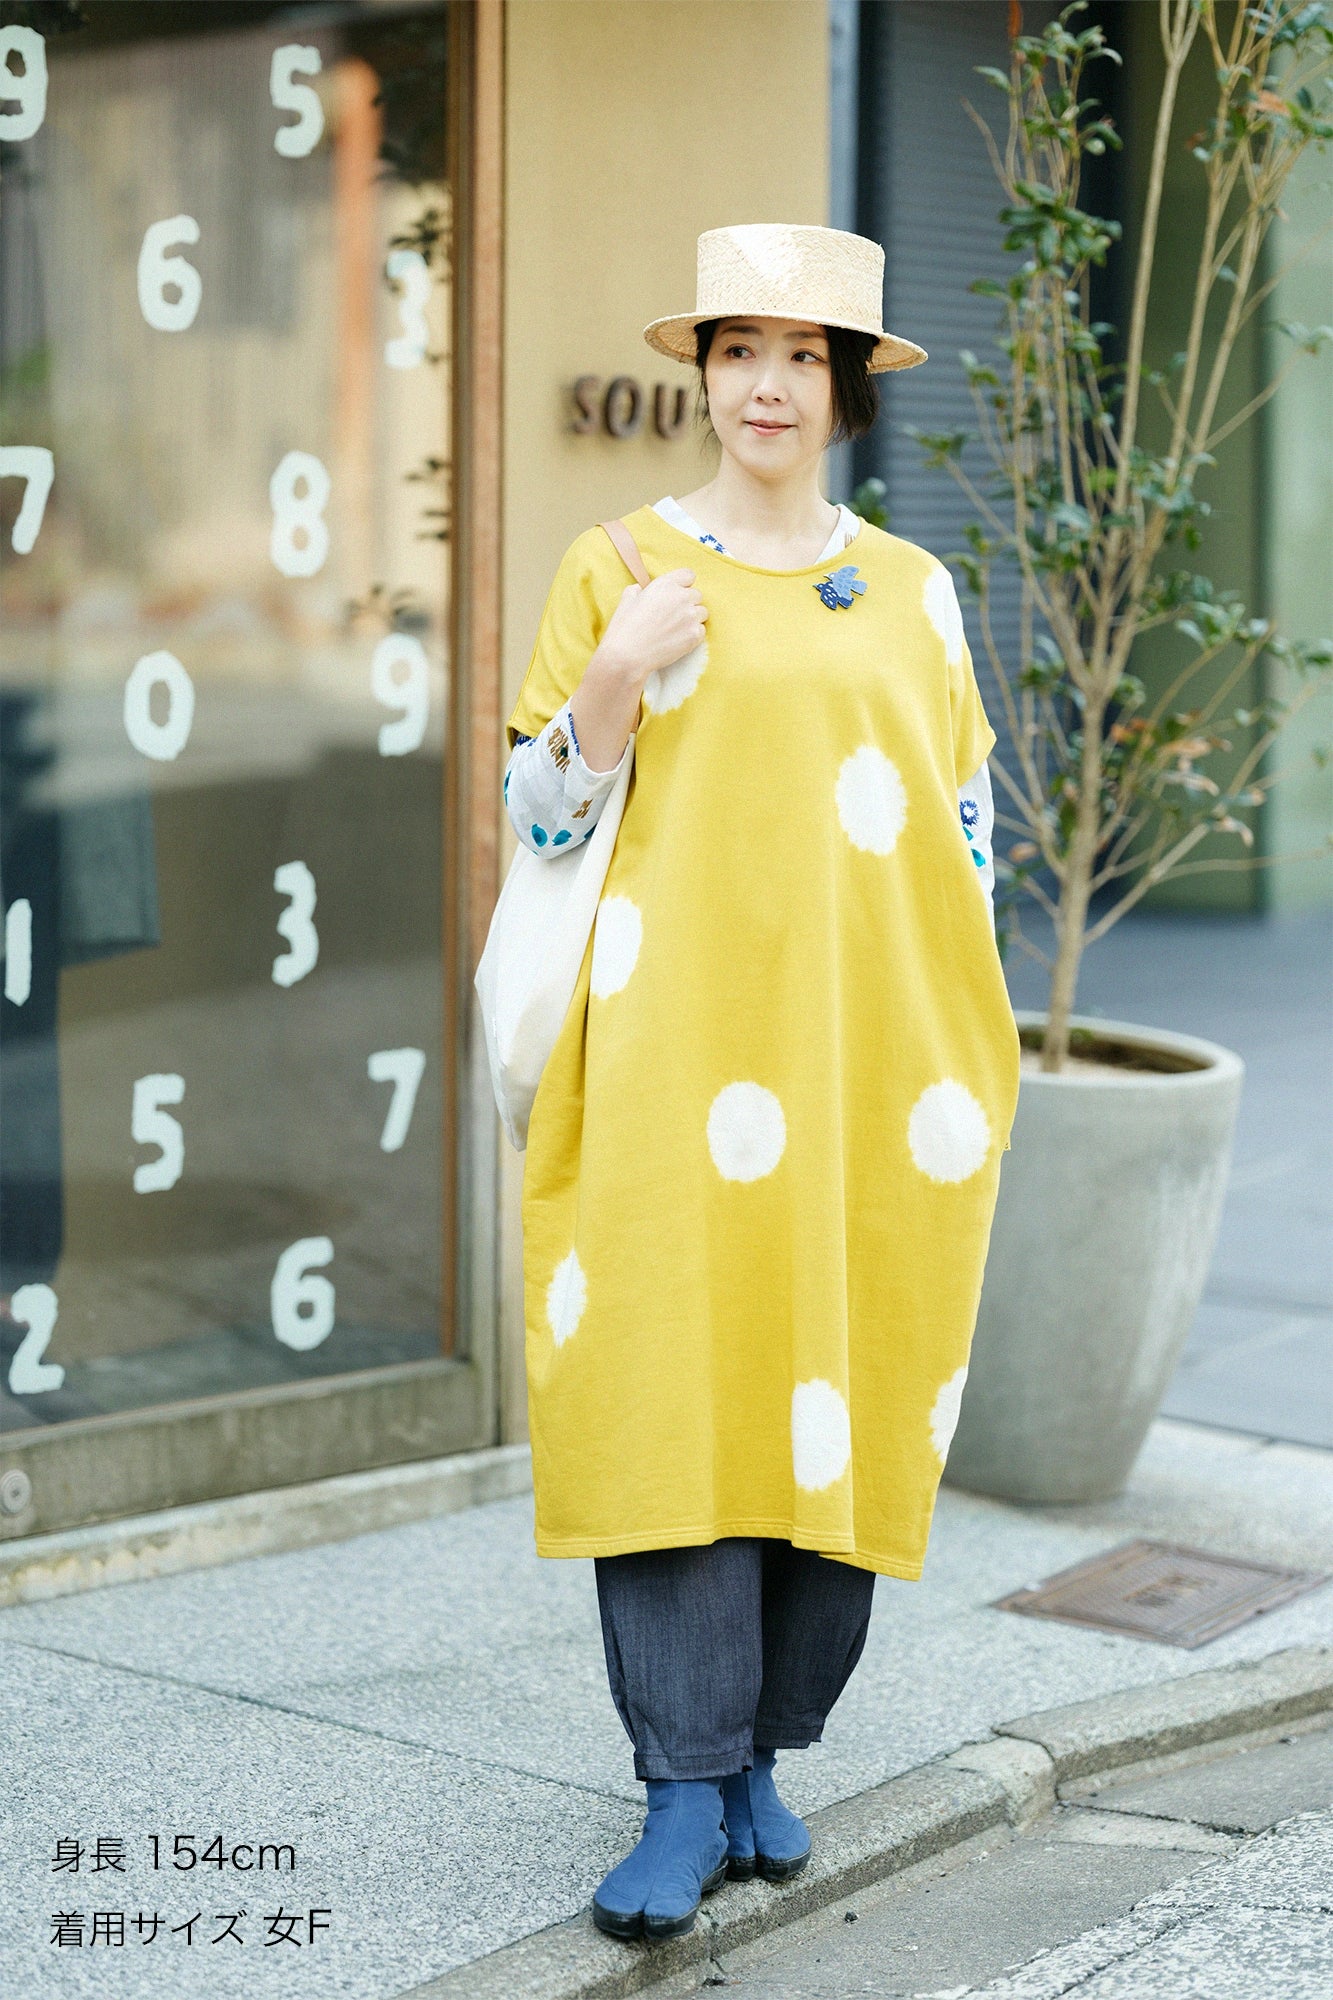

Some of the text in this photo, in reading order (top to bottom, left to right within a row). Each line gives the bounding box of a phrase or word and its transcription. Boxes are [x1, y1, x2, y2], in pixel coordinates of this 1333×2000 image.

[0, 24, 48, 142] 9
[269, 43, 325, 158] 5
[137, 213, 202, 332] 6
[384, 249, 431, 370] 3
[571, 374, 687, 440] SOU
[0, 445, 55, 555] 7
[269, 449, 330, 578] 8
[123, 649, 196, 761] 0
[371, 632, 430, 757] 9
[272, 860, 319, 988] 3
[131, 1073, 186, 1194] 5
[367, 1047, 426, 1153] 7
[8, 1283, 66, 1394] 2
[270, 1235, 336, 1352] 6
